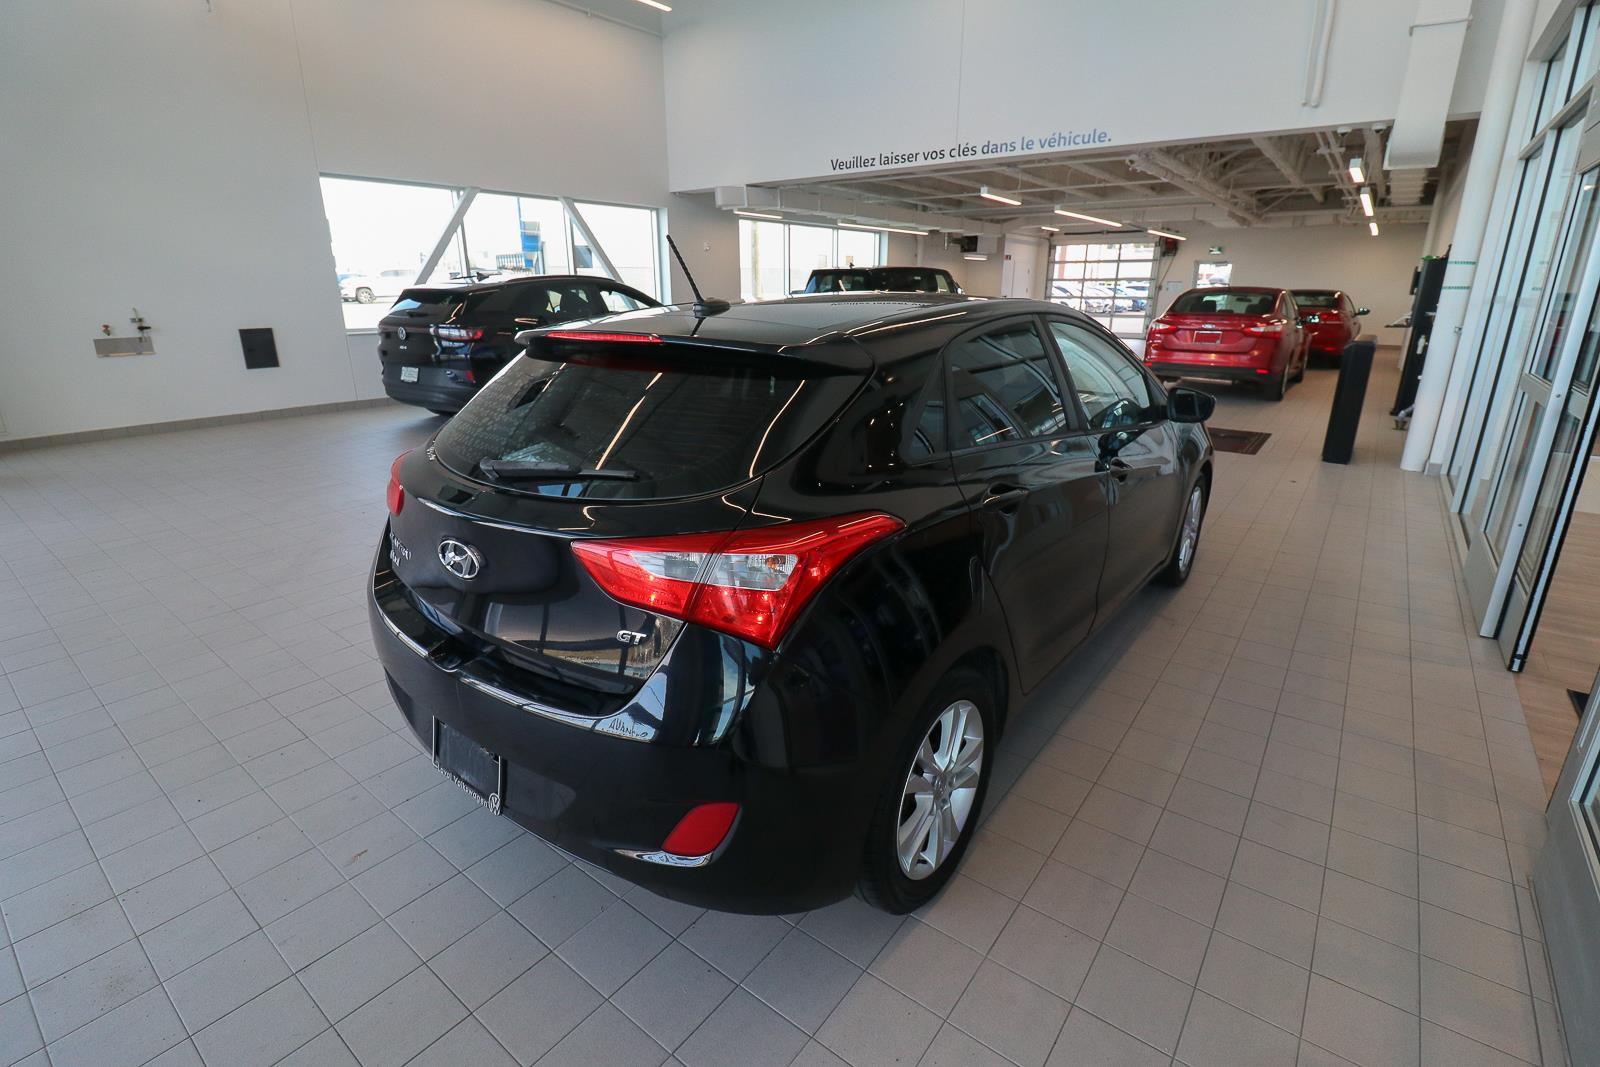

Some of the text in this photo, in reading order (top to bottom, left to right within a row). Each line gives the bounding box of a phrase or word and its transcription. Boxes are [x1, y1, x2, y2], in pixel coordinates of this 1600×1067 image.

[831, 128, 1112, 171] Veuillez laisser vos clés dans le véhicule.
[616, 630, 647, 645] GT
